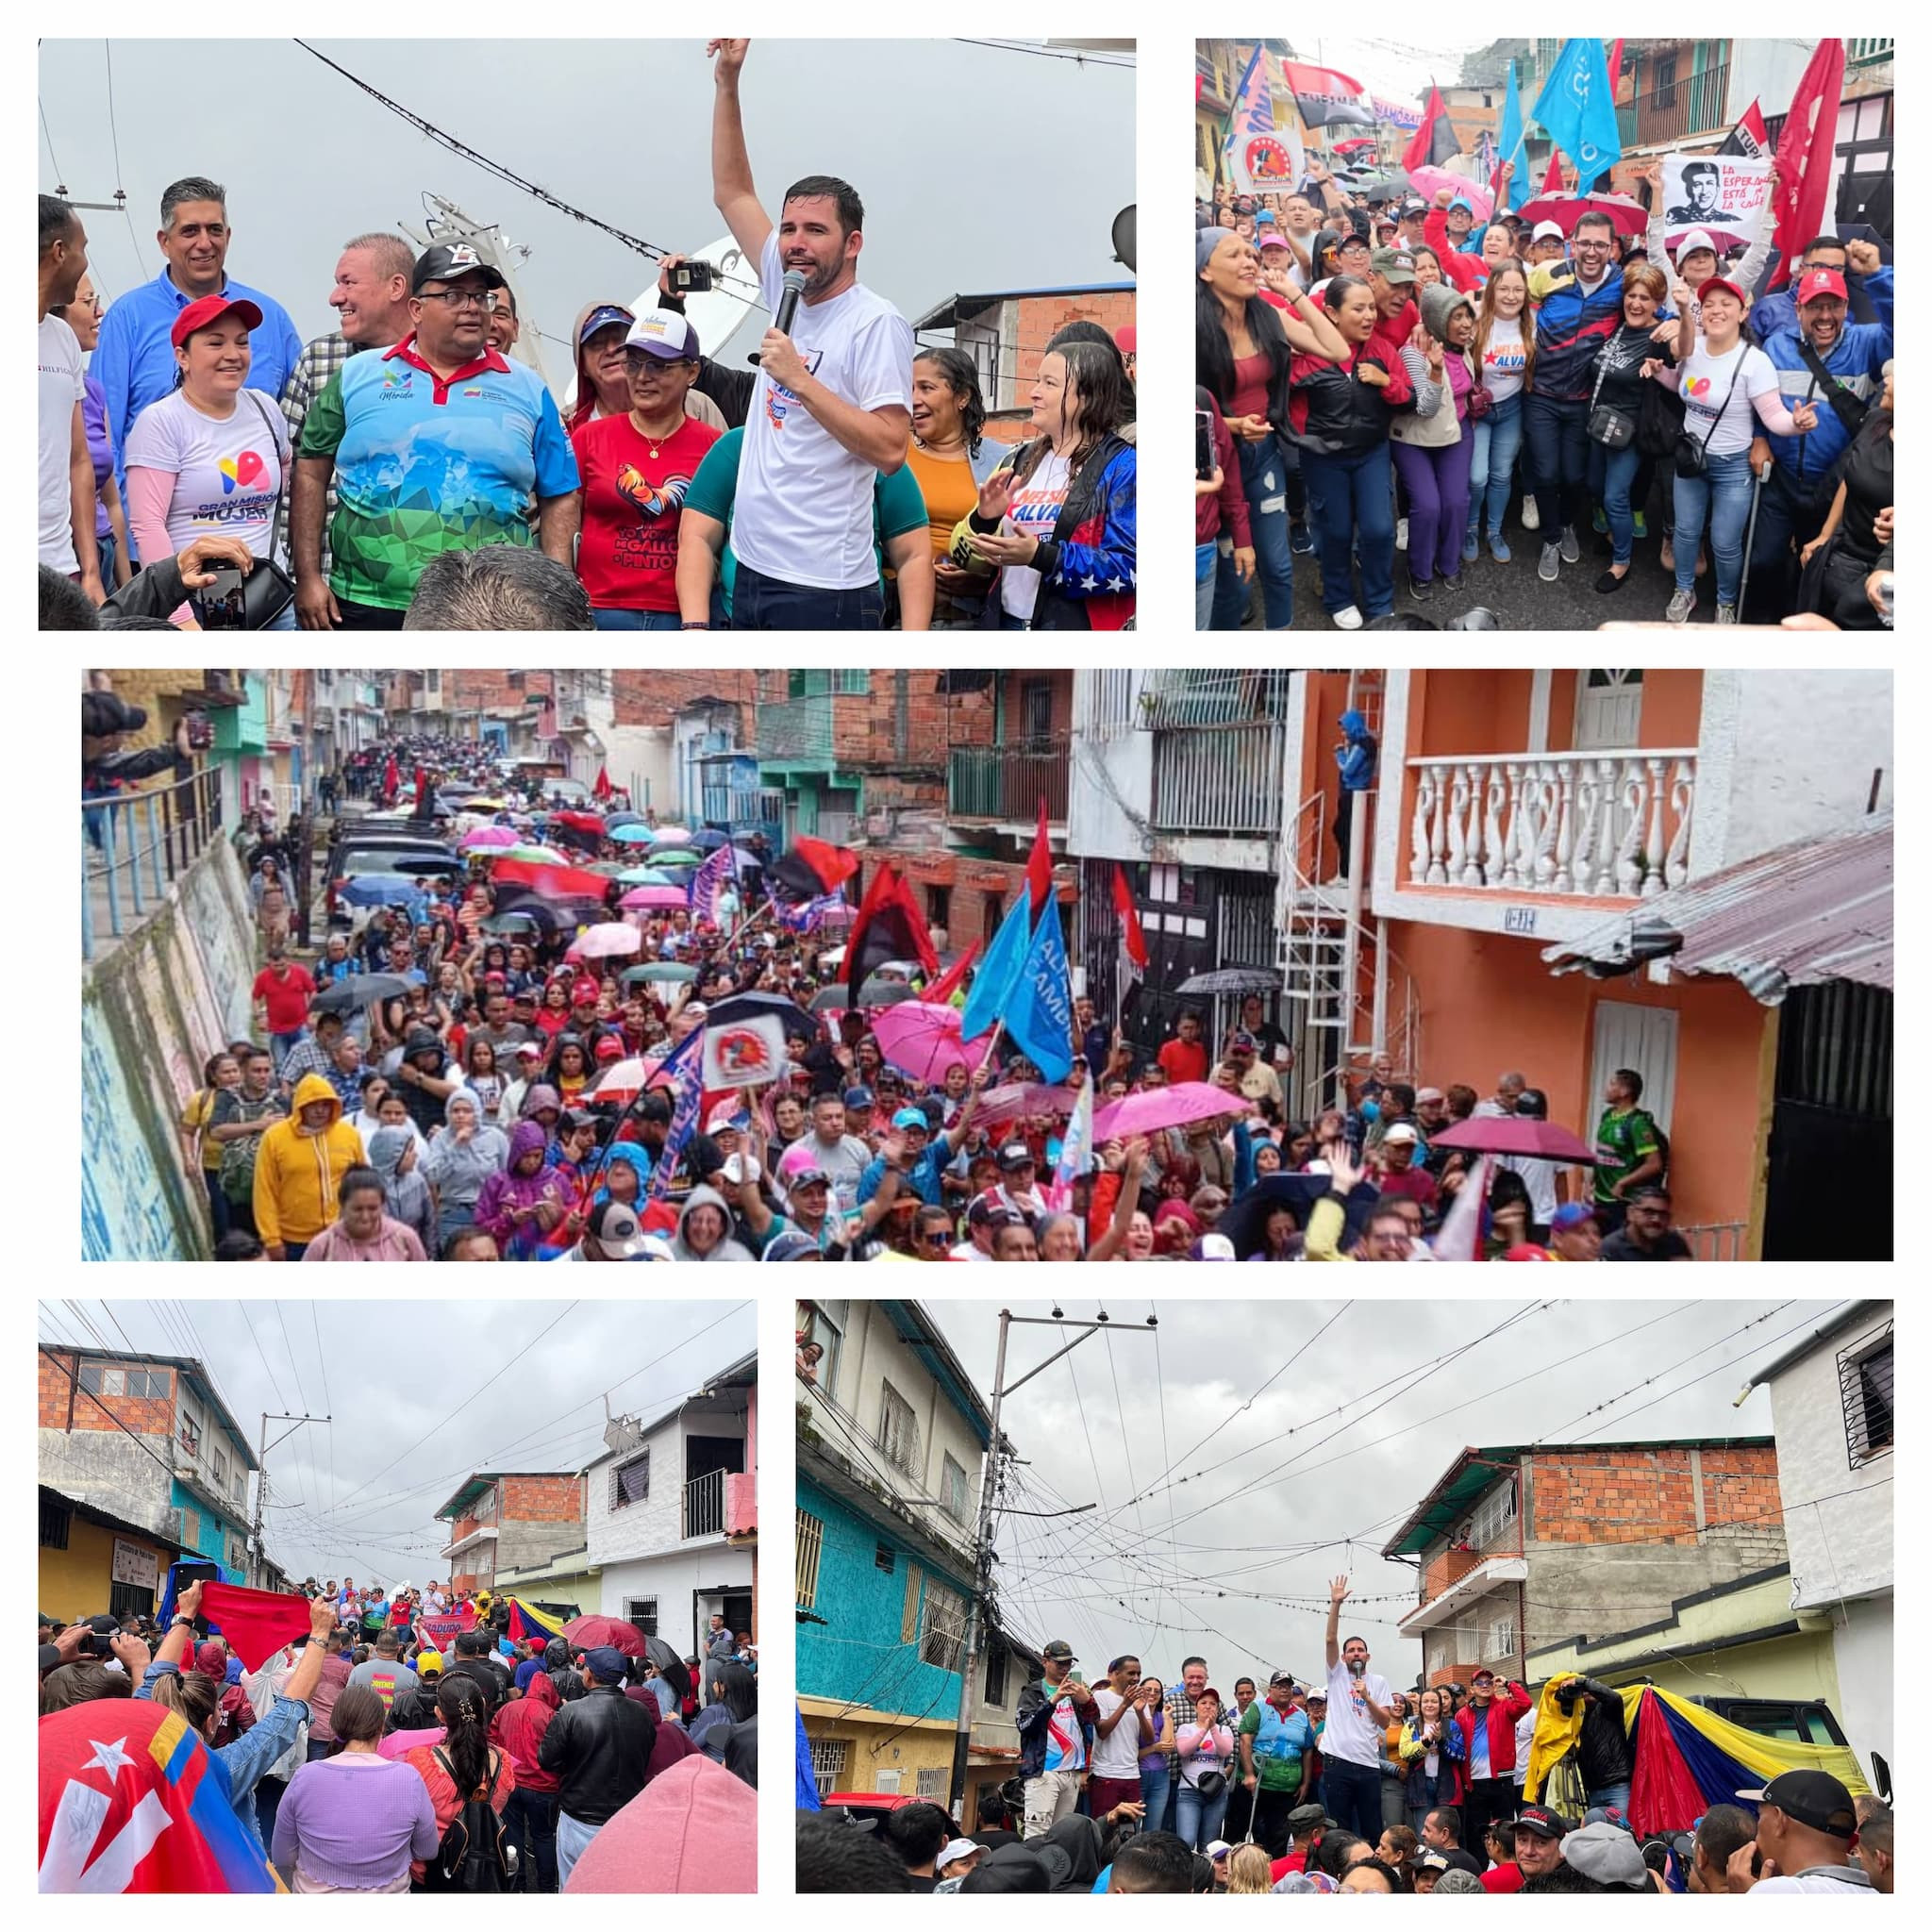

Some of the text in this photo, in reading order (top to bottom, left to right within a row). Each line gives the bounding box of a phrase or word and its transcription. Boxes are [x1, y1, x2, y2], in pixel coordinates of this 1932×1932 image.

[1723, 165, 1735, 175] LA
[199, 499, 238, 511] GRAN
[192, 506, 268, 522] MUJER
[1013, 504, 1063, 522] ALVA
[619, 528, 637, 539] YO
[623, 553, 673, 570] PINTO
